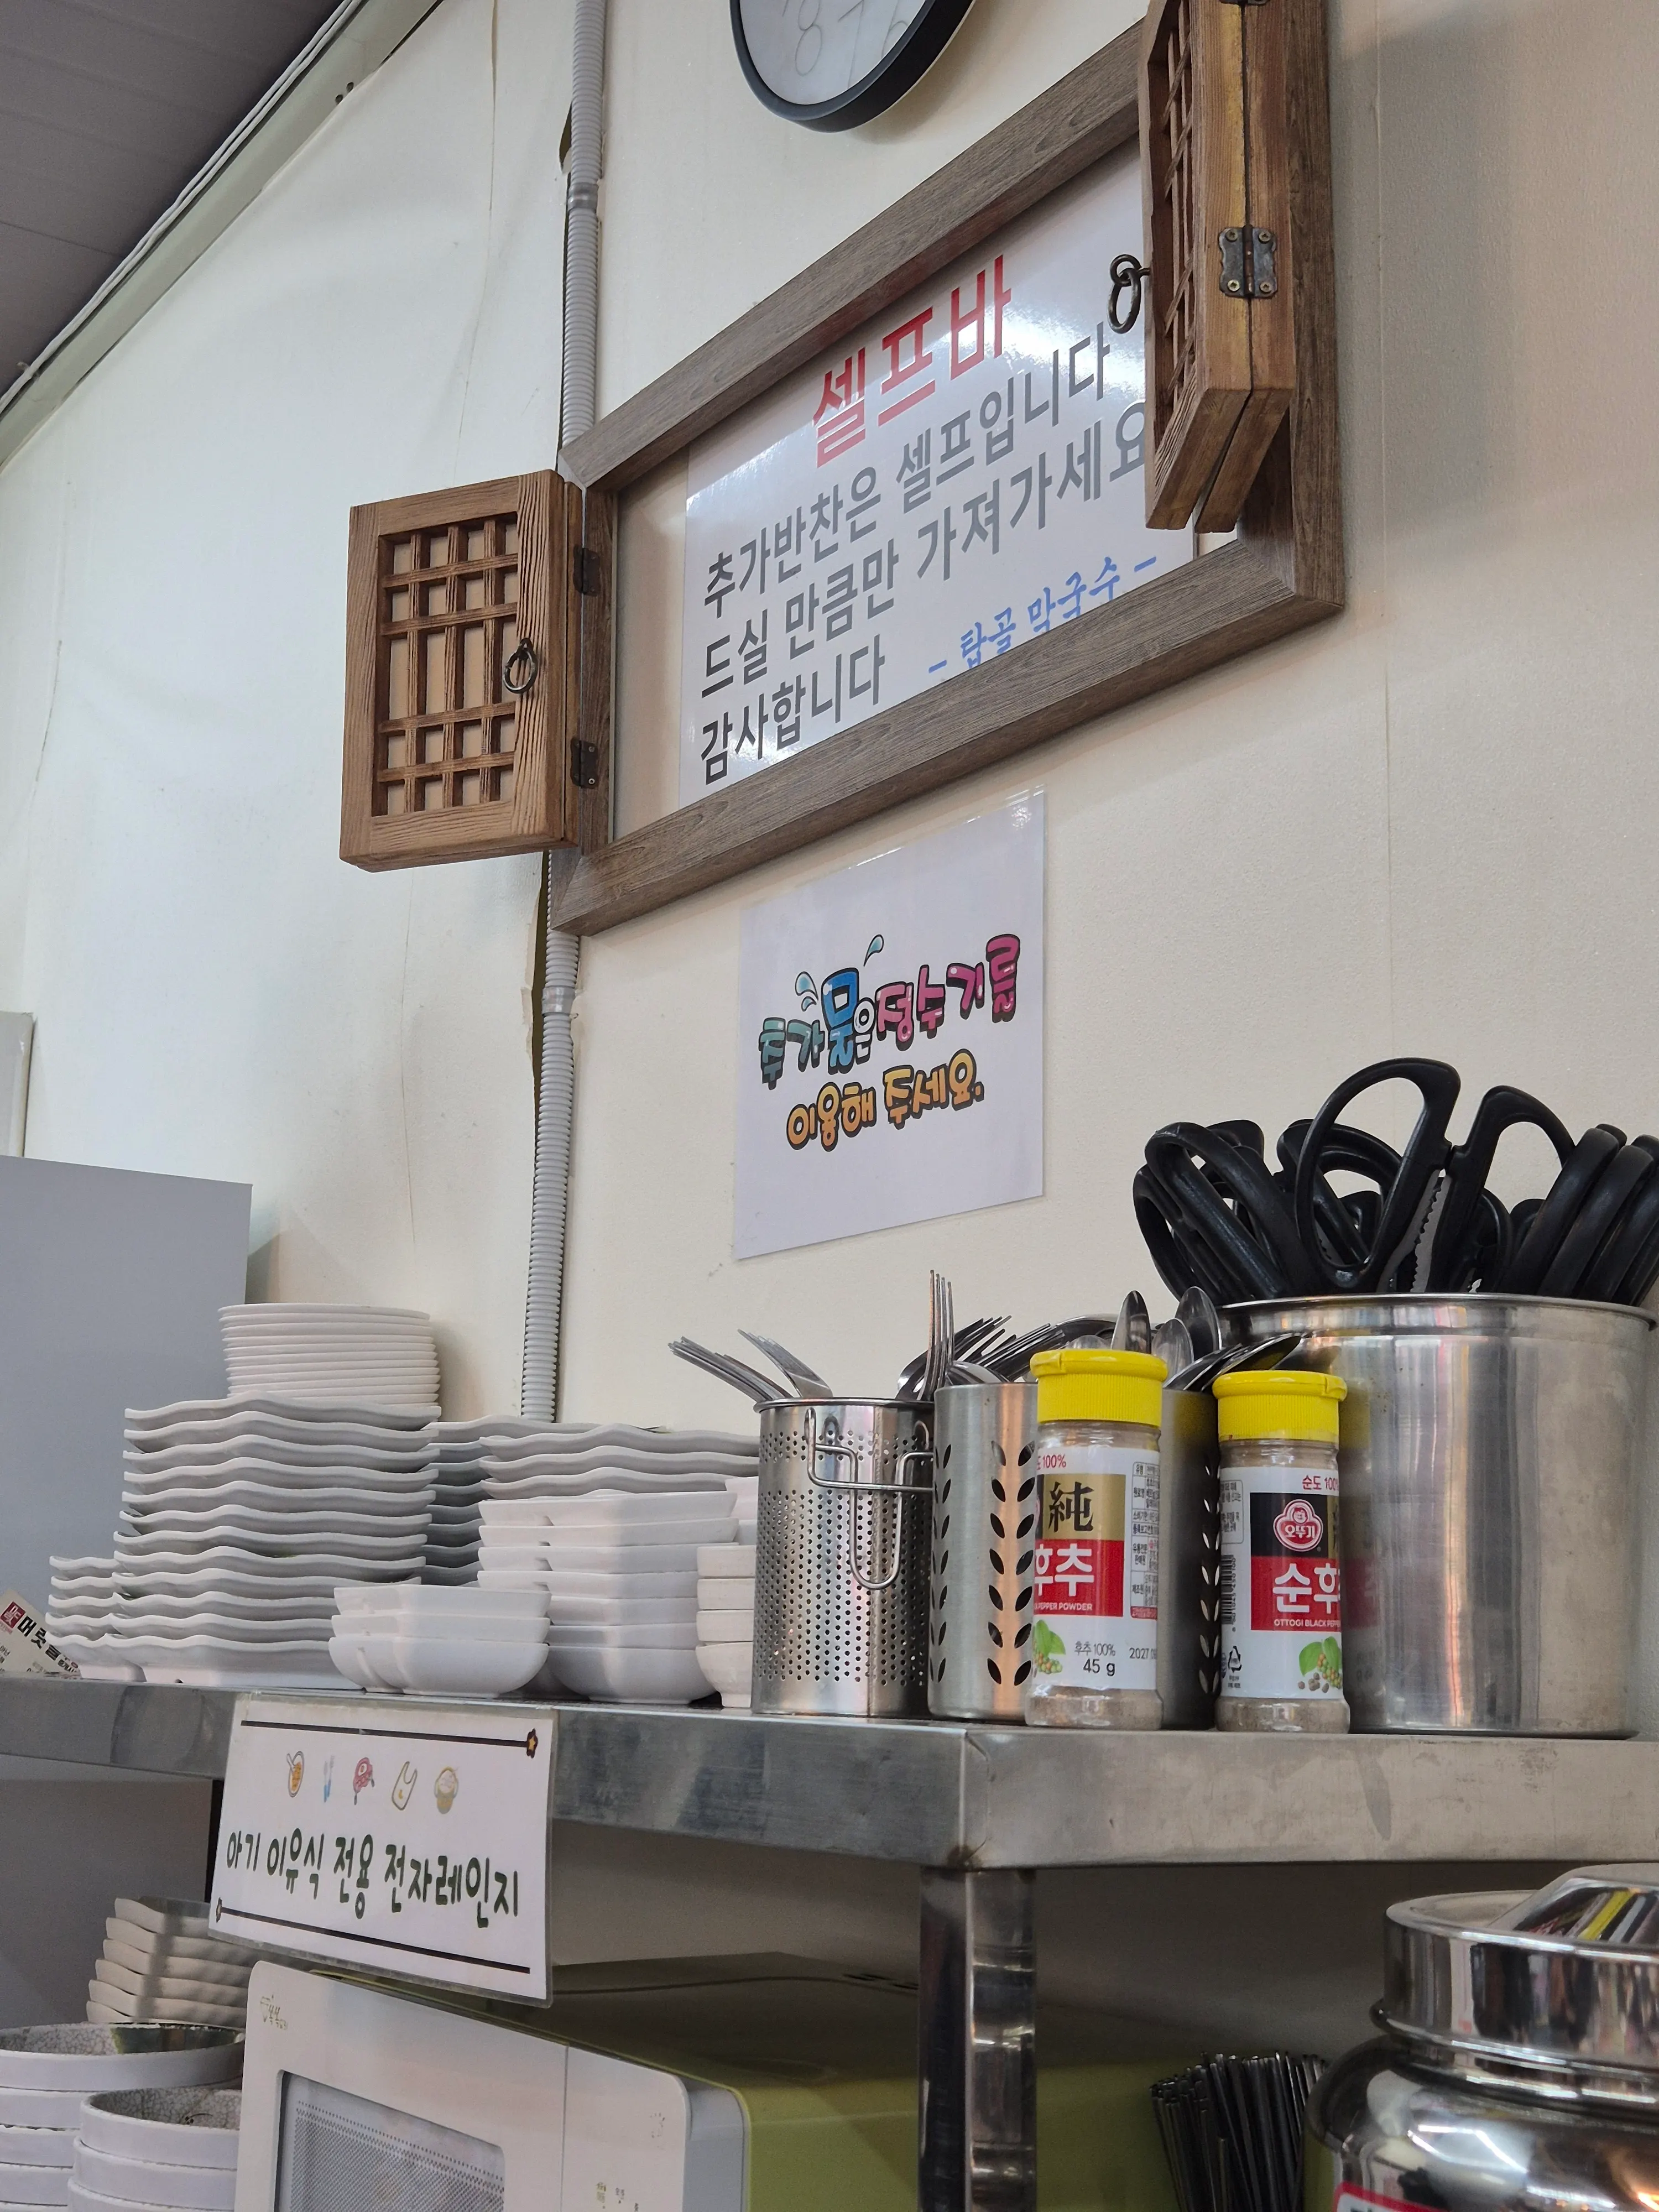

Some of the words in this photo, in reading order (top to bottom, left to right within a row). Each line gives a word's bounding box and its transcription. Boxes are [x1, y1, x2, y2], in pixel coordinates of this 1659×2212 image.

[813, 254, 1011, 468] 셀프바
[705, 467, 881, 619] 추가반찬은
[896, 322, 1110, 513] 셀프입니다
[702, 608, 768, 698] 드실
[786, 539, 899, 657] 만큼만
[916, 401, 1145, 580] 가져가세요
[961, 607, 1016, 669] 탑골
[1028, 556, 1120, 632] 막국수
[701, 634, 885, 785] 감사합니다
[786, 1082, 877, 1152] 이용해
[883, 1048, 984, 1129] 주세요.
[1042, 1454, 1066, 1468] 100%
[1302, 1475, 1322, 1490] 순도
[1048, 1481, 1094, 1532] 純
[1285, 1525, 1315, 1538] 오뚜기
[1058, 1602, 1093, 1611] POWDER
[1272, 1563, 1340, 1614] 순후
[1074, 1641, 1092, 1656] 후추
[1093, 1643, 1116, 1656] 100%
[1083, 1658, 1100, 1673] 45
[1106, 1662, 1115, 1677] g
[227, 1830, 260, 1871] 아기
[267, 1828, 325, 1899] 이유식
[333, 1834, 373, 1919] 전용
[385, 1844, 518, 1928] 전자레인지
